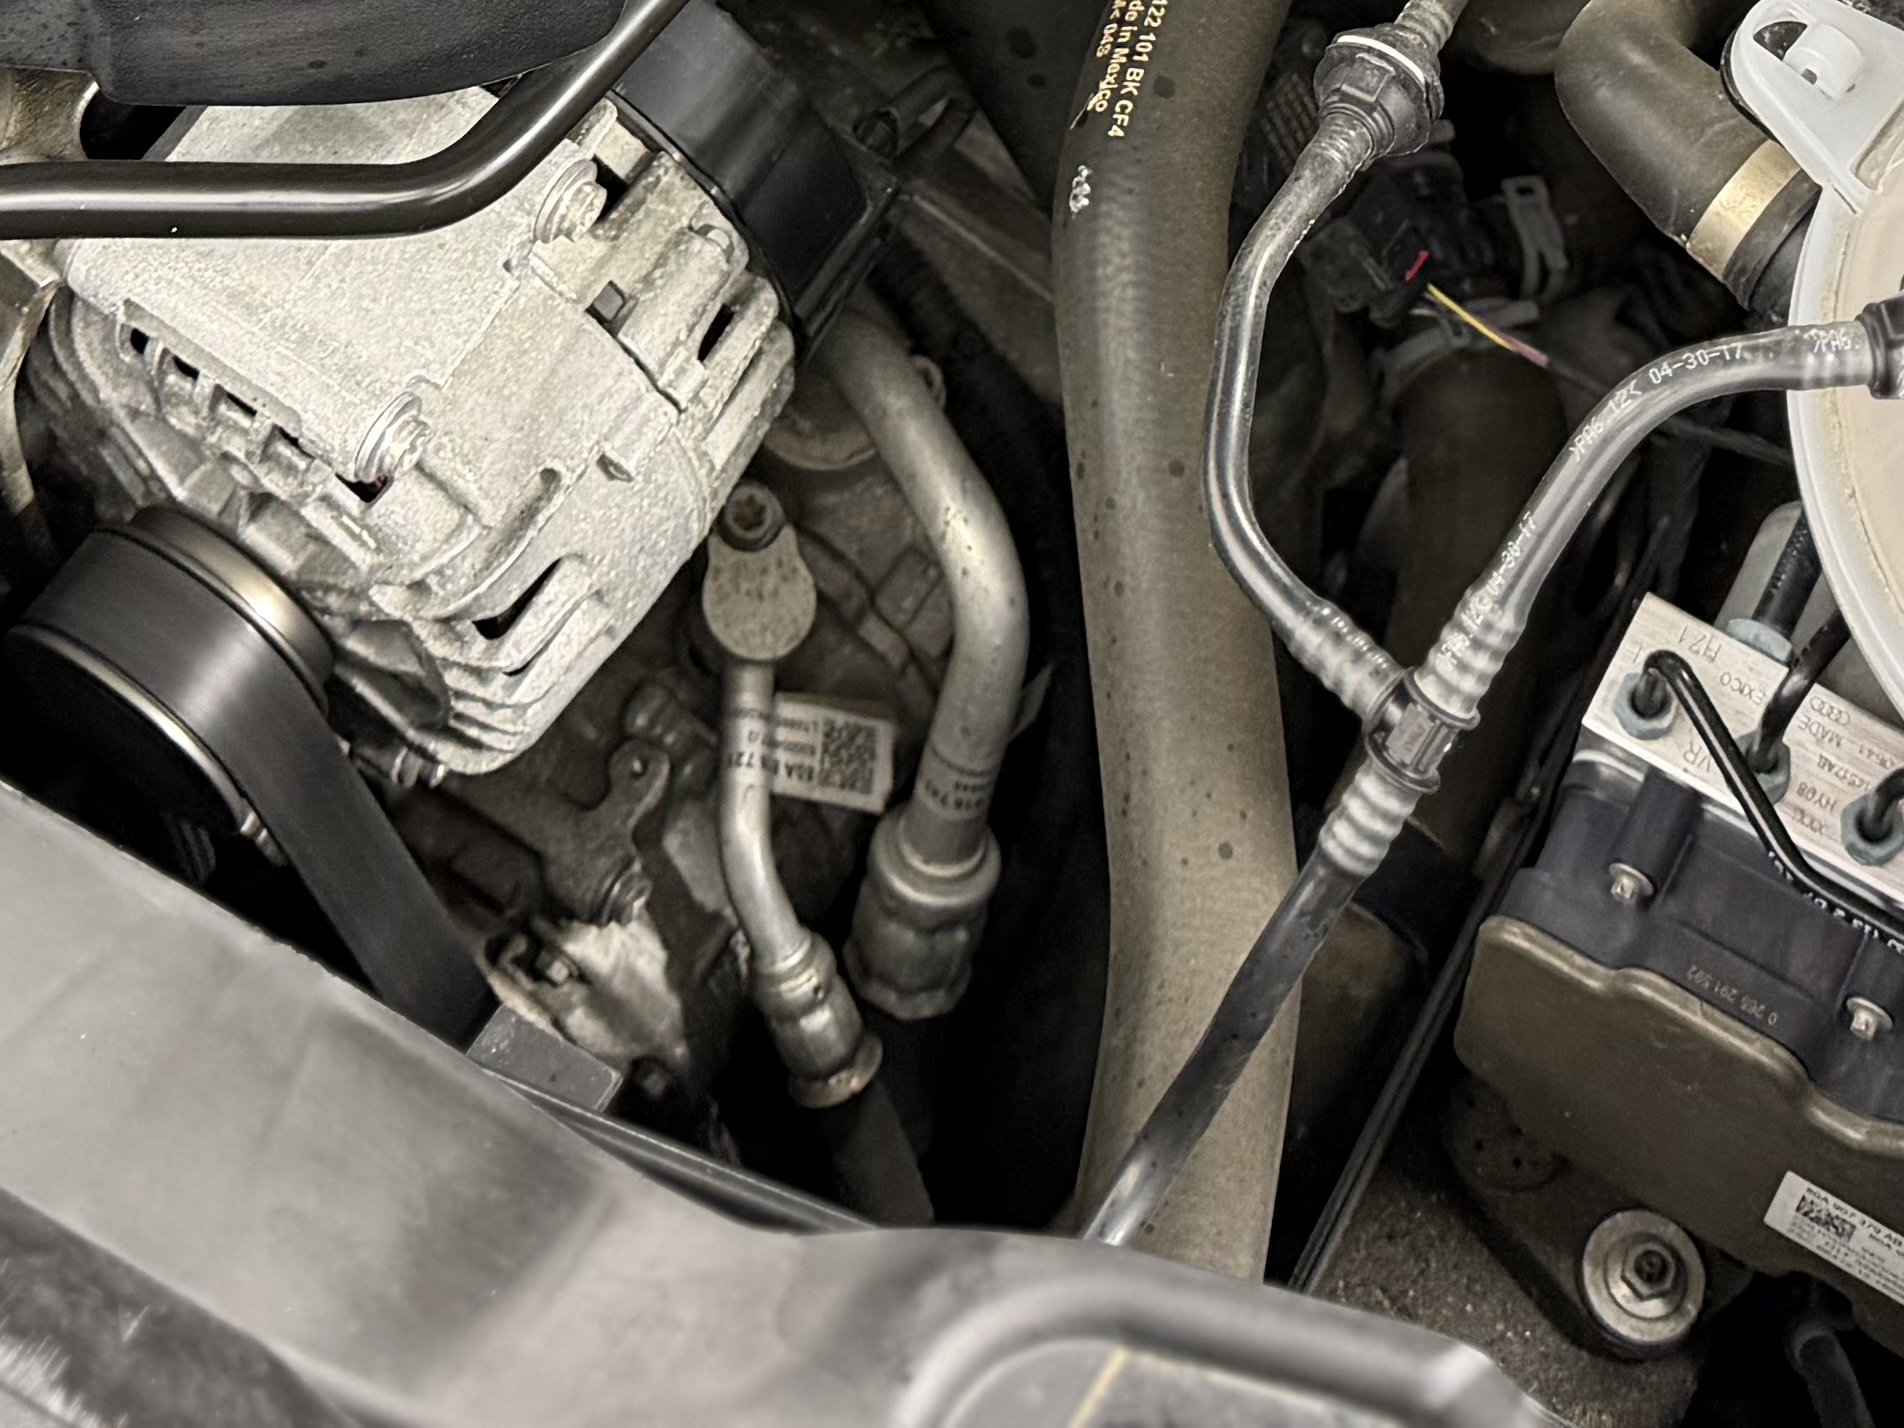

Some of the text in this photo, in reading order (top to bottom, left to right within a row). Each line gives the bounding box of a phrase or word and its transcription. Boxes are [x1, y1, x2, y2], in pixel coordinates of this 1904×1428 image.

[1117, 25, 1138, 43] in
[1132, 33, 1156, 62] 101
[1094, 47, 1130, 113] Mexico
[1120, 67, 1145, 96] BK
[1107, 99, 1134, 137] CF4
[1648, 343, 1745, 385] 04-30-17
[1719, 671, 1843, 748] MADE EXICO
[1682, 740, 1714, 774] VR
